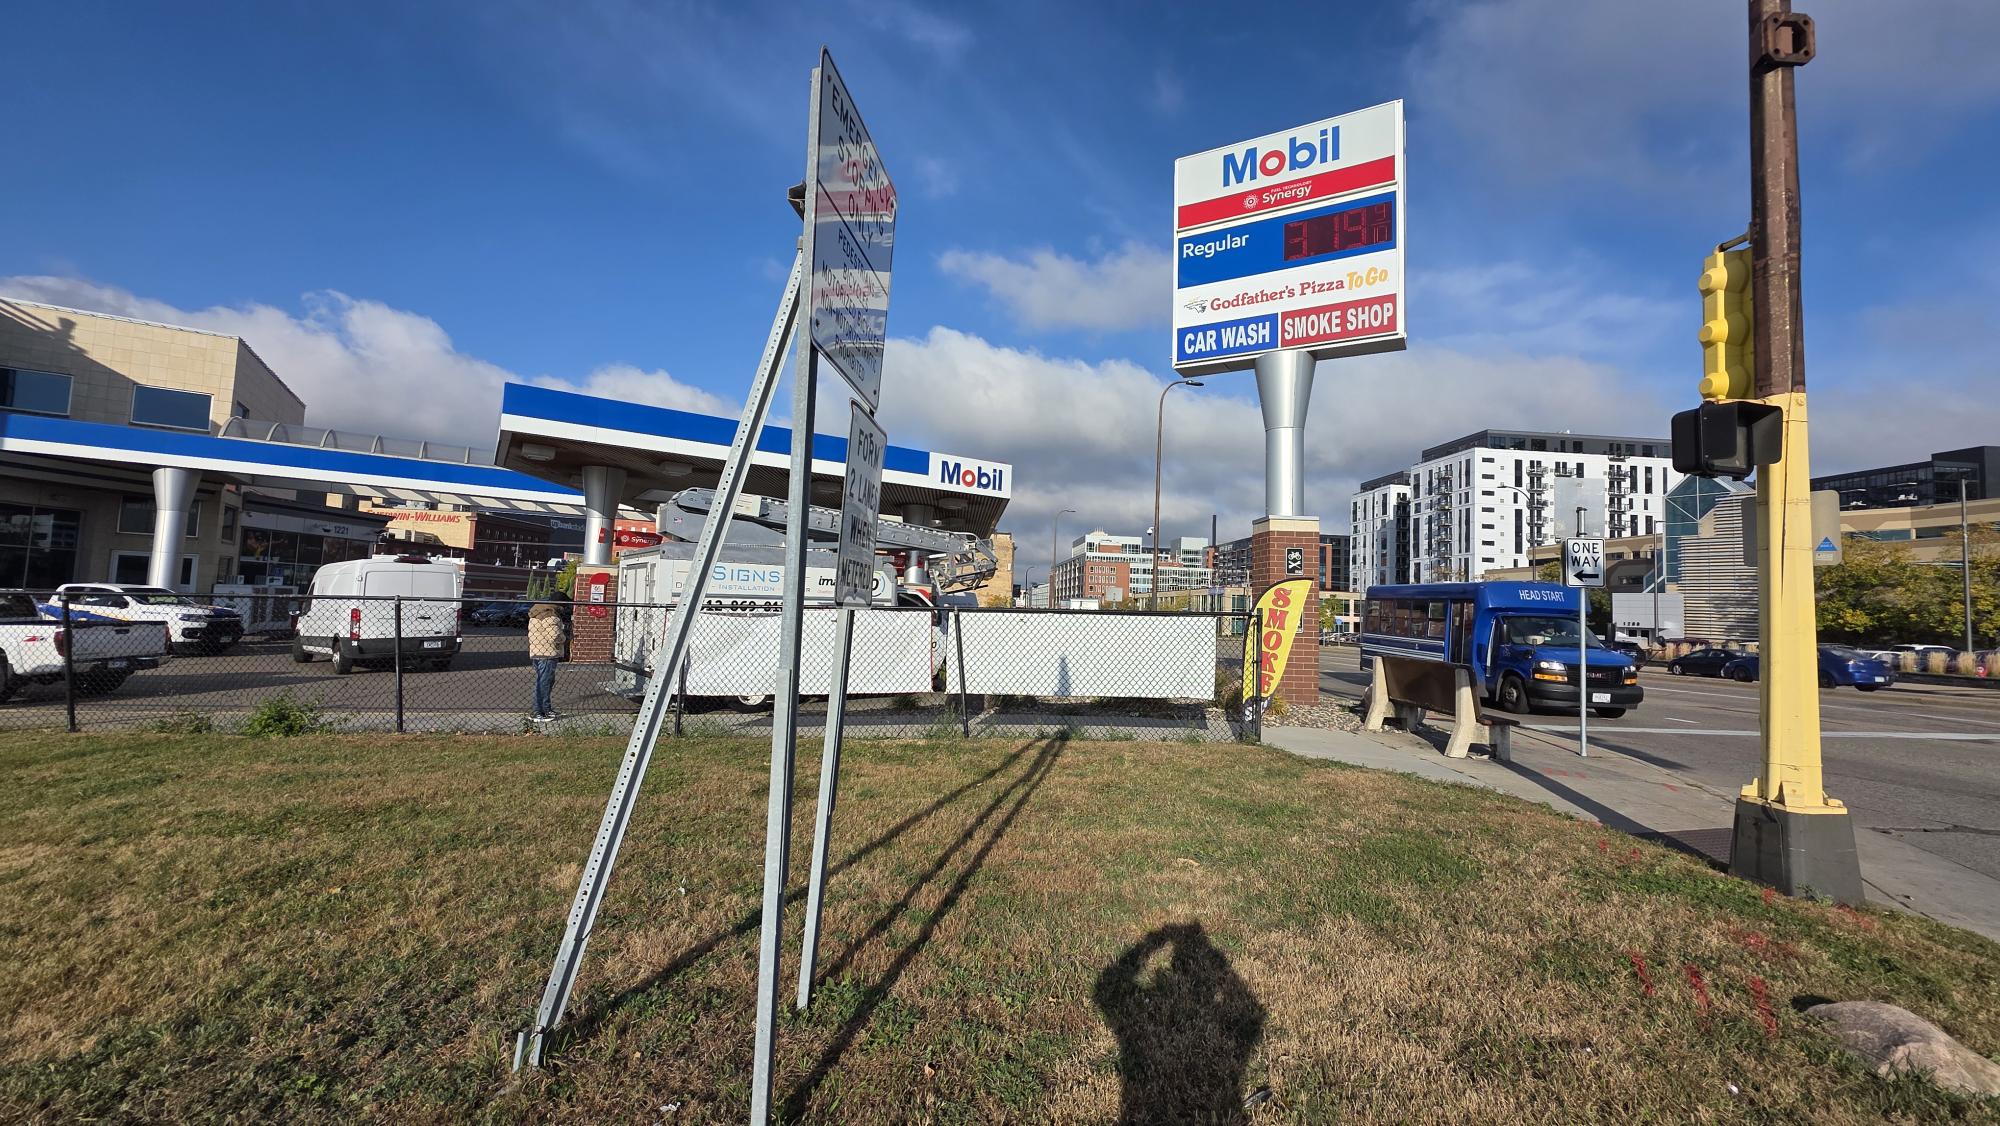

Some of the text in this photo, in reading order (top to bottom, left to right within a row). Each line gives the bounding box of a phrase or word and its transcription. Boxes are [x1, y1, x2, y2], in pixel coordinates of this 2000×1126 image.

[832, 83, 891, 211] EMERGENCY
[1222, 125, 1340, 188] Mobil
[838, 135, 884, 236] STOPPING
[1262, 185, 1312, 205] Synergy
[848, 193, 873, 249] ONLY
[838, 228, 875, 297] PEDESTRIANS
[1182, 233, 1250, 259] Regular
[821, 259, 857, 318] MOTORIZED
[843, 262, 868, 312] BICYCLES
[1210, 285, 1296, 311] Godfather's
[1299, 279, 1345, 297] Pizza
[1184, 321, 1270, 354] CAR WASH
[1284, 303, 1393, 340] SMOKE SHOP
[835, 334, 865, 382] PROHIBITED
[857, 428, 880, 471] FORM
[849, 470, 879, 514] 2 LANES
[940, 459, 1003, 491] Mobil
[334, 525, 349, 535] 1221
[631, 536, 658, 545] Synergy
[849, 514, 874, 550] WHEN
[1571, 542, 1600, 554] ONE
[1571, 555, 1600, 568] WAY
[712, 565, 781, 583] SIGNS
[718, 584, 775, 592] INSTALLATION
[841, 557, 872, 592] METERED
[1519, 589, 1565, 602] HEAD START
[1261, 587, 1292, 694] SMOKE
